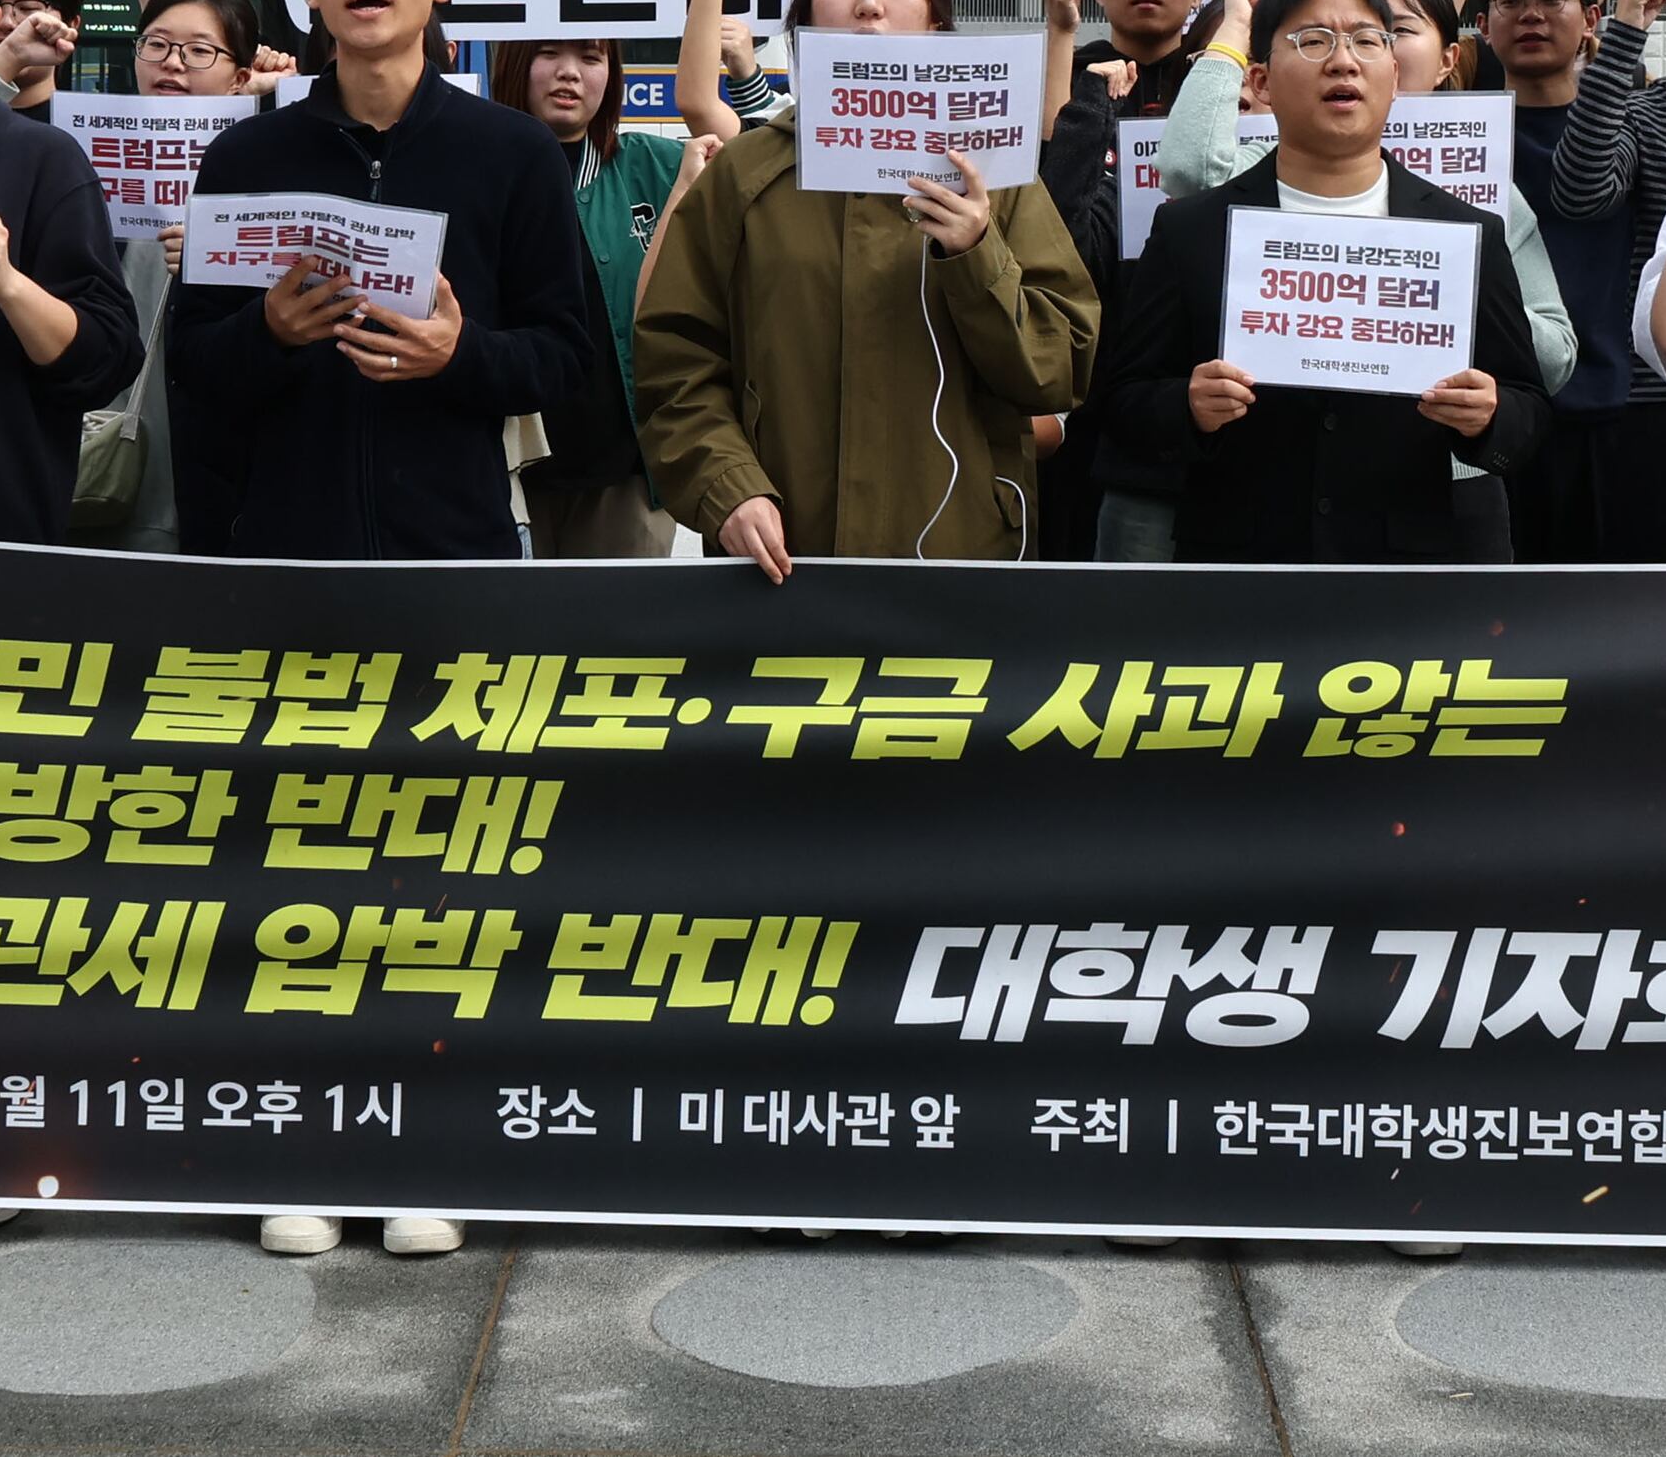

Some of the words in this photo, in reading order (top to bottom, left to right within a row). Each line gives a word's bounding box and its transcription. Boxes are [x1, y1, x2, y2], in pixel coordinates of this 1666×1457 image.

[832, 61, 908, 81] 트럼프의
[913, 62, 1009, 83] 날강도적인
[831, 88, 937, 119] 3500억
[947, 88, 1009, 119] 달러
[815, 127, 864, 149] 투자
[869, 128, 916, 153] 강요
[924, 127, 1023, 154] 중단하라!
[214, 213, 230, 223] 전
[233, 210, 296, 223] 세계적인
[301, 211, 347, 227] 약탈적
[350, 221, 380, 236] 관세
[385, 226, 415, 240] 압박
[206, 250, 304, 267] 지구를
[235, 225, 389, 267] 트럼프는
[1263, 240, 1339, 263] 트럼프의
[1345, 246, 1440, 270] 날강도적인
[1259, 269, 1366, 305] 3500억
[1378, 278, 1439, 311] 달러
[1240, 311, 1289, 336] 투자
[1297, 315, 1343, 340] 강요
[1351, 319, 1455, 348] 중단하라!
[1300, 358, 1390, 375] 한국대학생진보연합
[131, 645, 402, 748] 불법
[1005, 661, 1285, 761] 사과
[1303, 658, 1571, 761] 않는
[261, 772, 563, 877] 반대!
[243, 903, 521, 1020] 압박
[541, 913, 861, 1028] 반대!
[893, 923, 1335, 1051] 대학생
[69, 1077, 187, 1131] 11일
[200, 1081, 305, 1134] 오후
[323, 1084, 405, 1137] 1시
[497, 1087, 598, 1140] 장소
[678, 1090, 725, 1144] 미
[742, 1093, 896, 1148] 대사관
[910, 1098, 961, 1150] 앞
[1030, 1100, 1129, 1154] 주최
